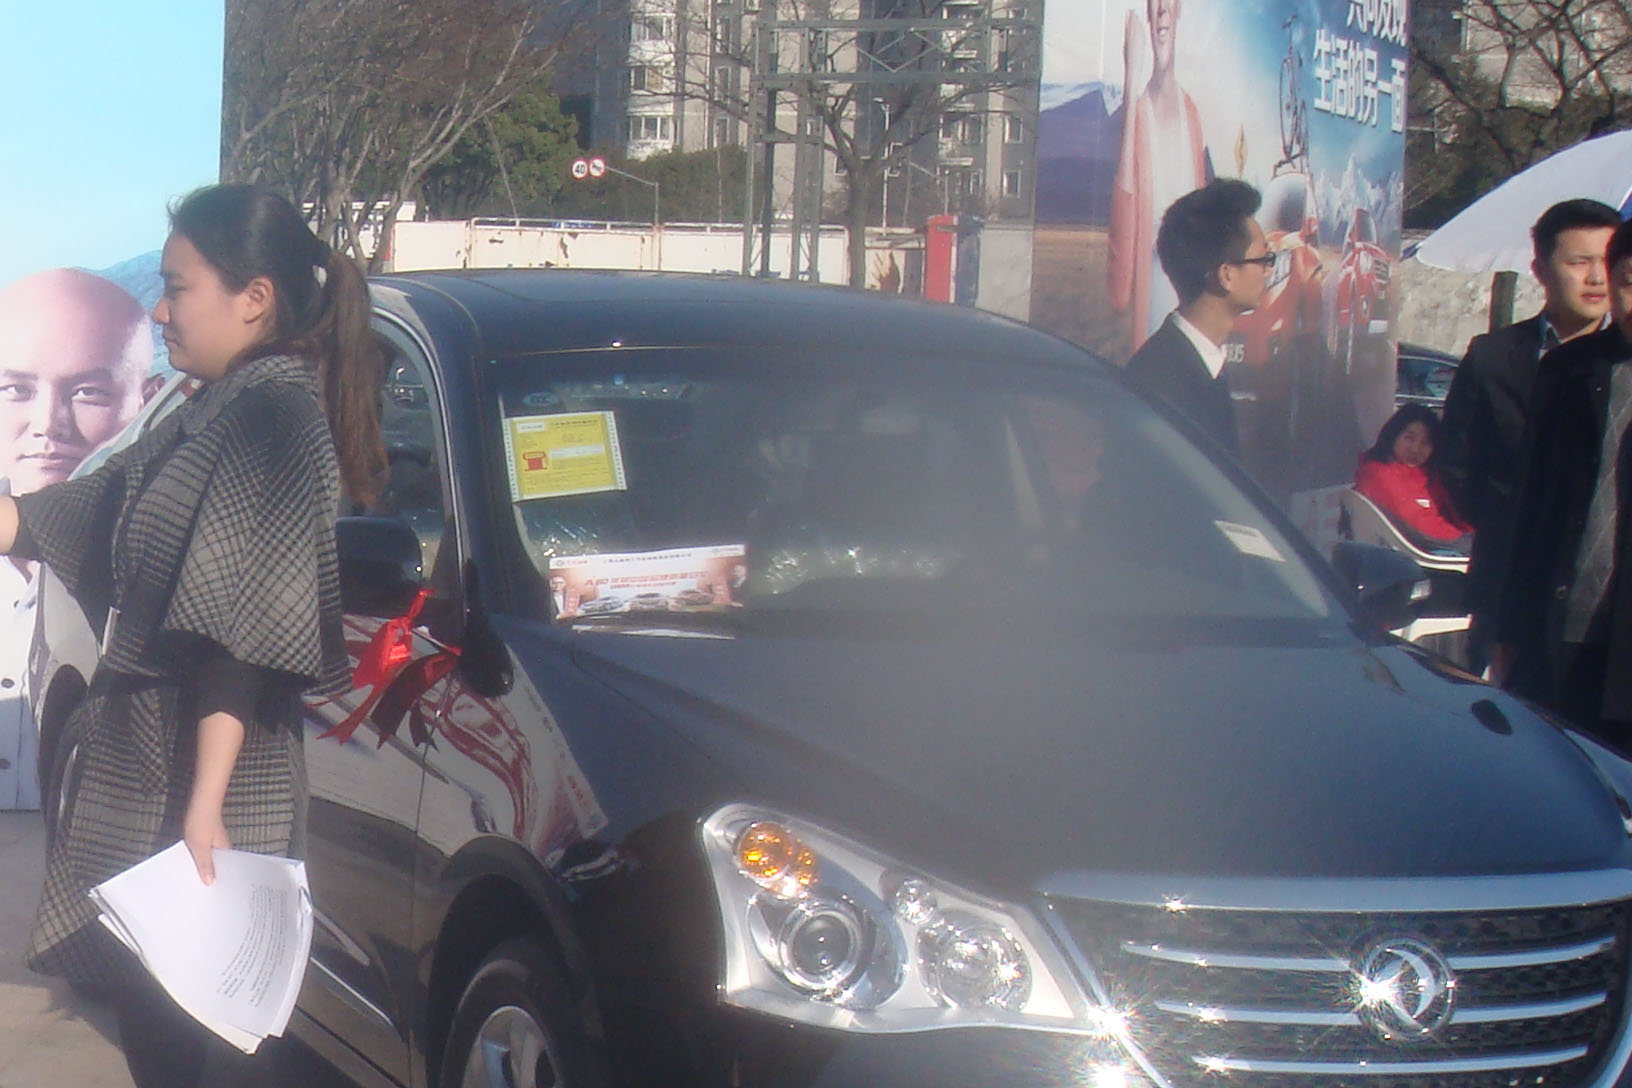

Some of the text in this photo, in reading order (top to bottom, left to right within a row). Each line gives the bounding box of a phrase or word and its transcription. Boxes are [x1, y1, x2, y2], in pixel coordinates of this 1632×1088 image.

[1313, 28, 1406, 133] 生活的另一面
